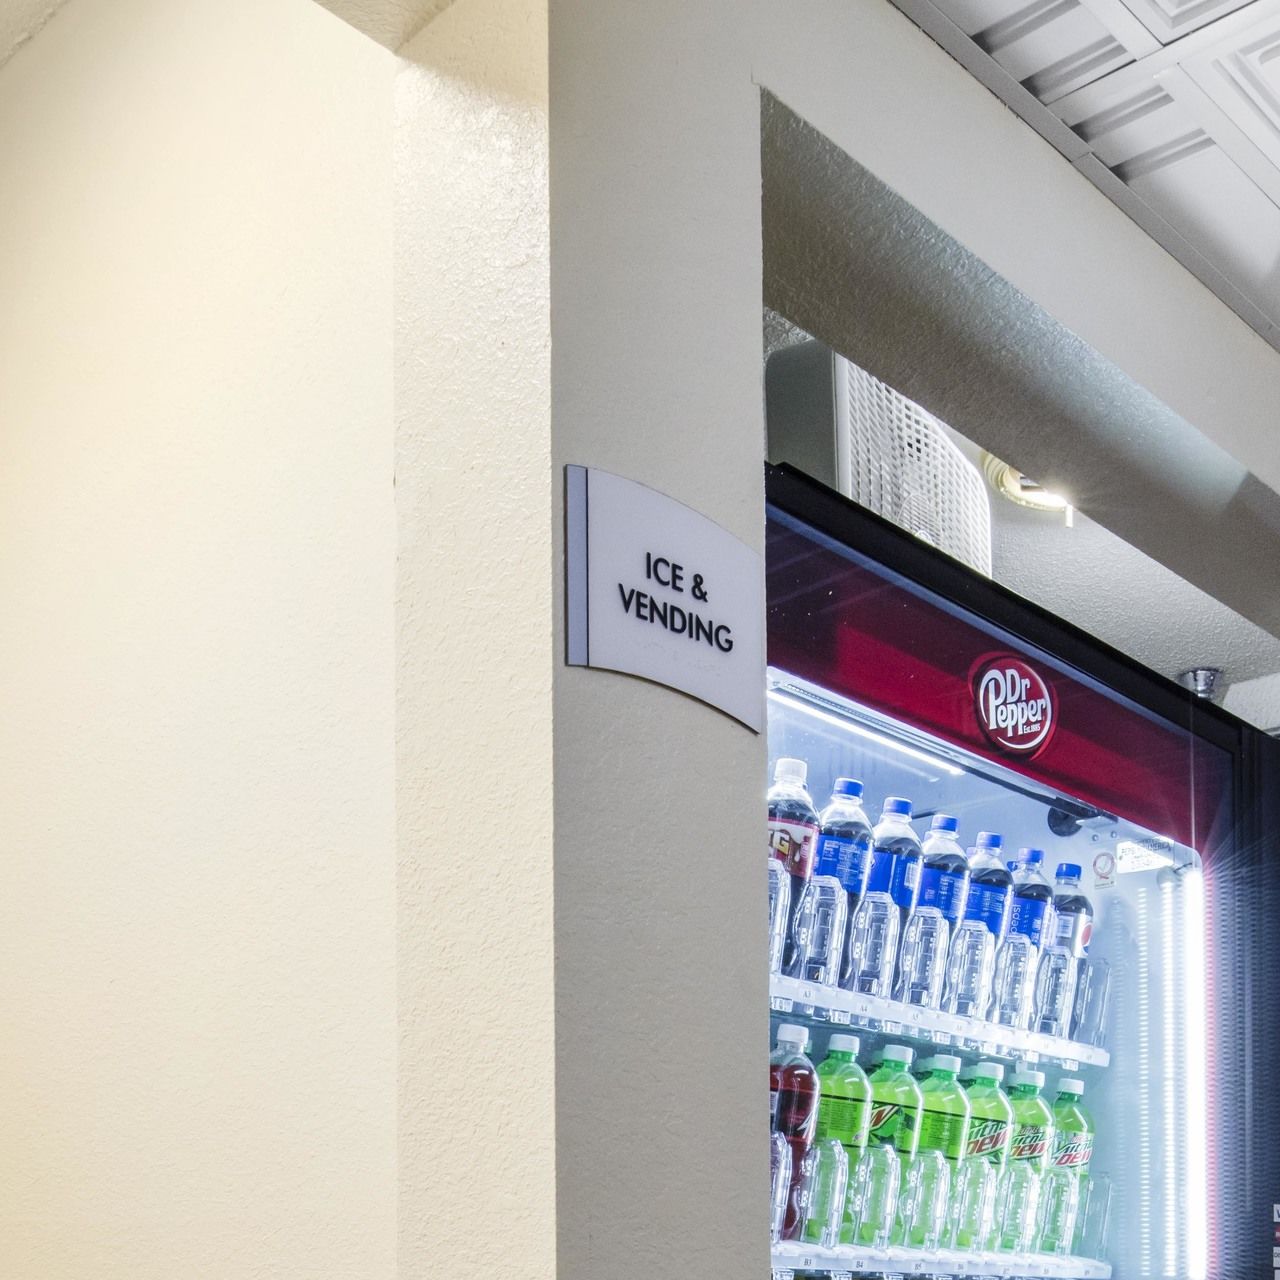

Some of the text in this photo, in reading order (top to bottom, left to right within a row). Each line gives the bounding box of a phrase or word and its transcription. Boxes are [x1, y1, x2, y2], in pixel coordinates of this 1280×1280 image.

[646, 552, 708, 603] ICE &
[618, 583, 734, 653] VENDING
[980, 669, 1047, 738] Pepper
[1005, 668, 1031, 704] Dr
[1010, 904, 1022, 935] pepsi
